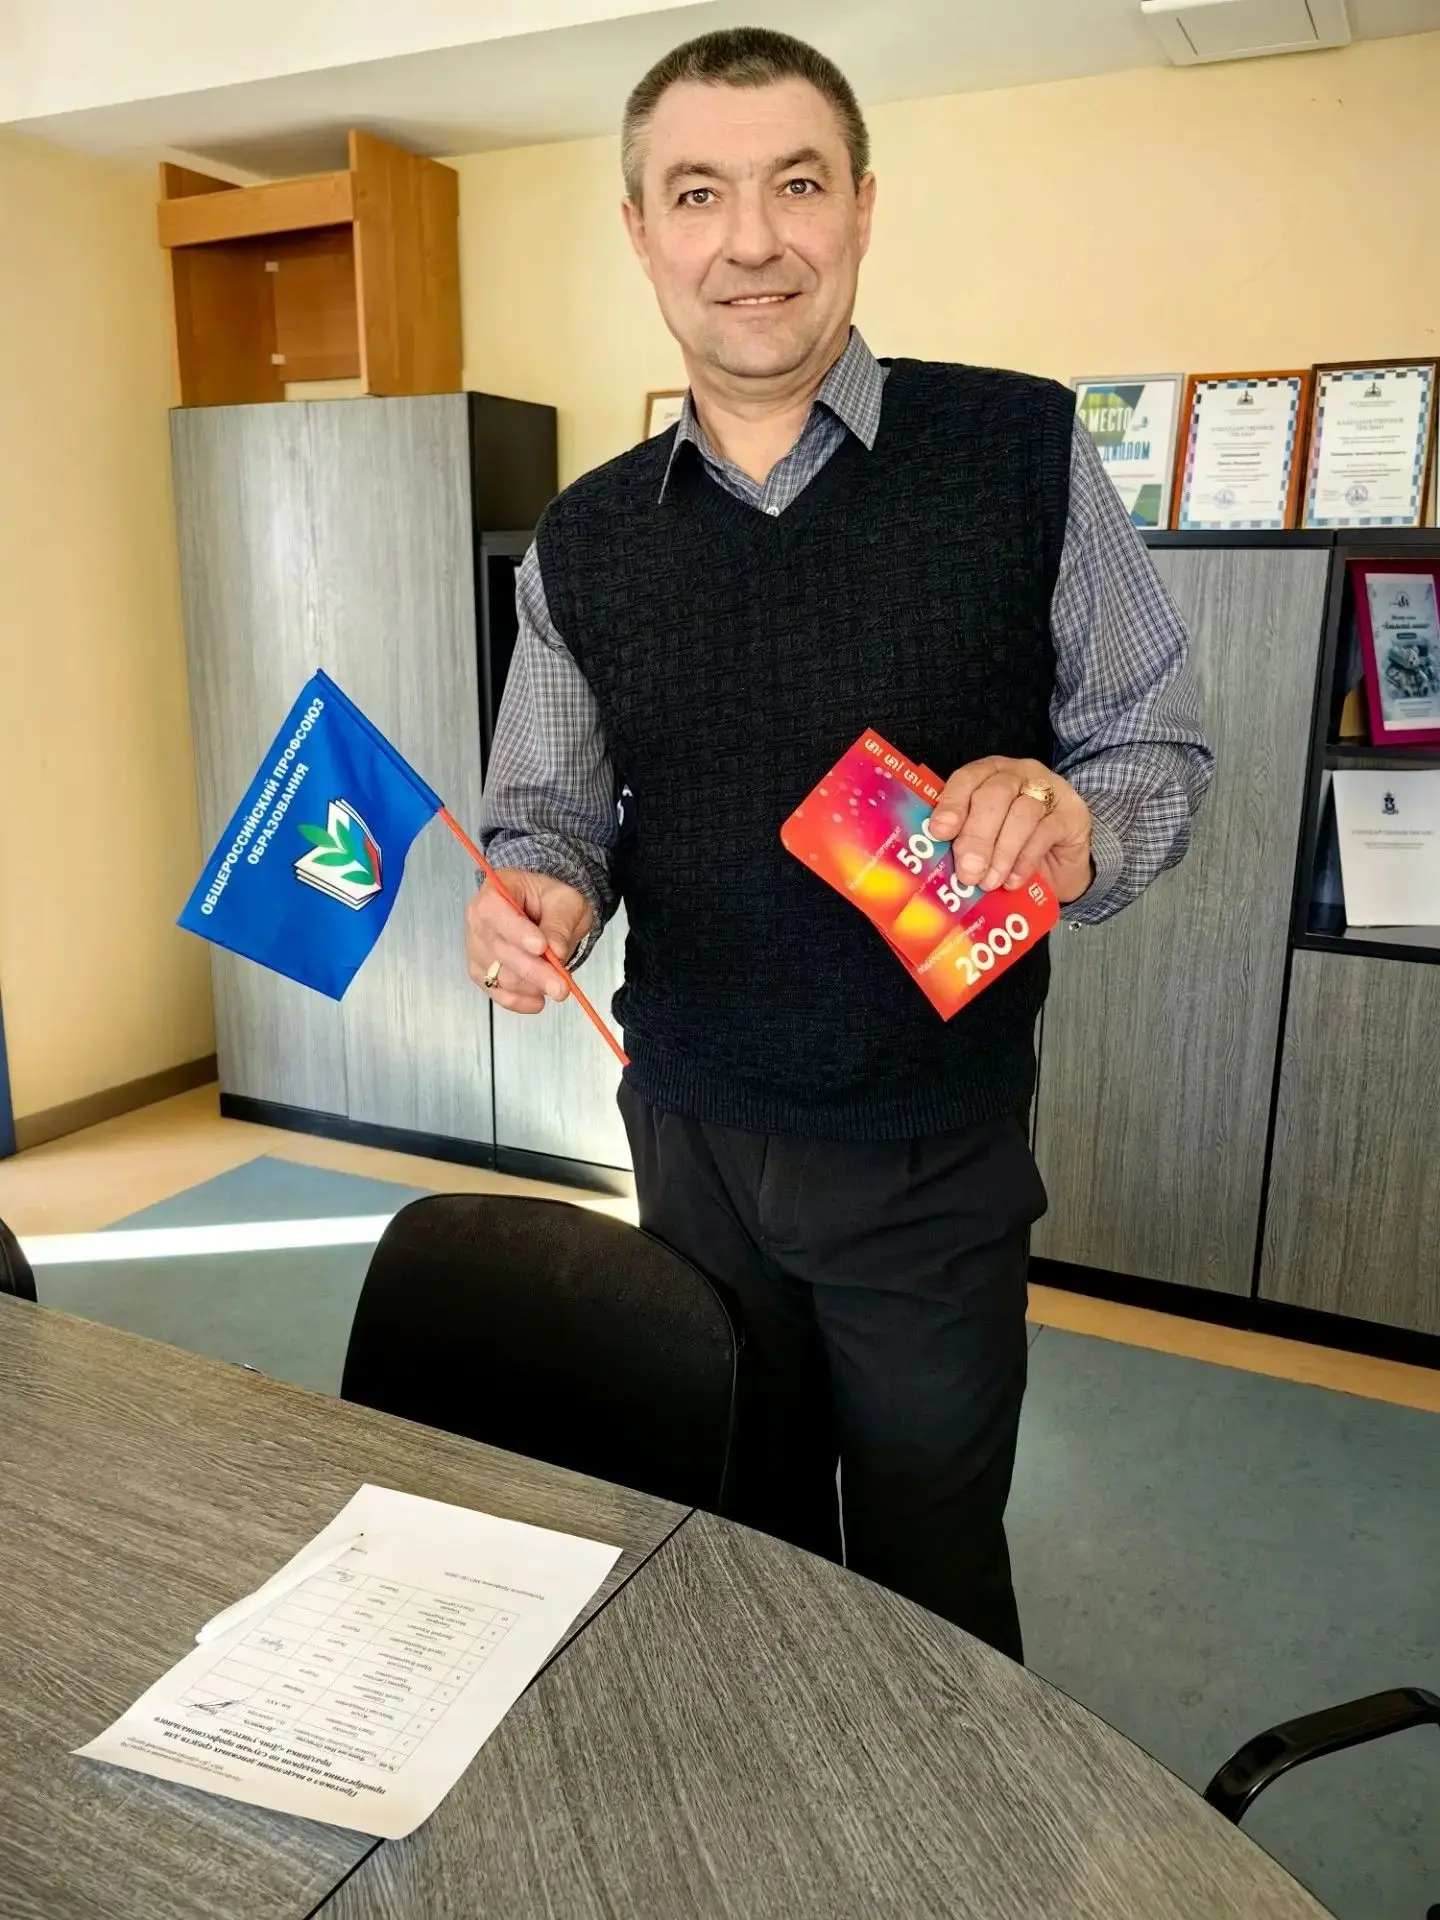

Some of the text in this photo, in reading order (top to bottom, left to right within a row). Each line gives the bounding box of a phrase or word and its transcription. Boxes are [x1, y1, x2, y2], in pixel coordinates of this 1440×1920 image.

[1088, 407, 1132, 433] МЕСТО
[1102, 441, 1151, 463] ДИПЛОМ
[200, 697, 325, 916] ОБЩЕРОССИЙСКИЙ ПРОФСОЮЗ
[246, 763, 309, 866] ОБРАЗОВАНИЯ
[955, 913, 1030, 986] 2000
[161, 1729, 182, 1740] для
[179, 1734, 215, 1750] средств
[216, 1726, 259, 1743] учителя»
[151, 1715, 387, 1796] приобретения подарков по случаю профессионального
[211, 1745, 259, 1765] денежных
[255, 1738, 287, 1753] «День
[283, 1747, 333, 1768] праздника
[256, 1759, 307, 1780] выделении
[311, 1777, 358, 1798] Протокол
